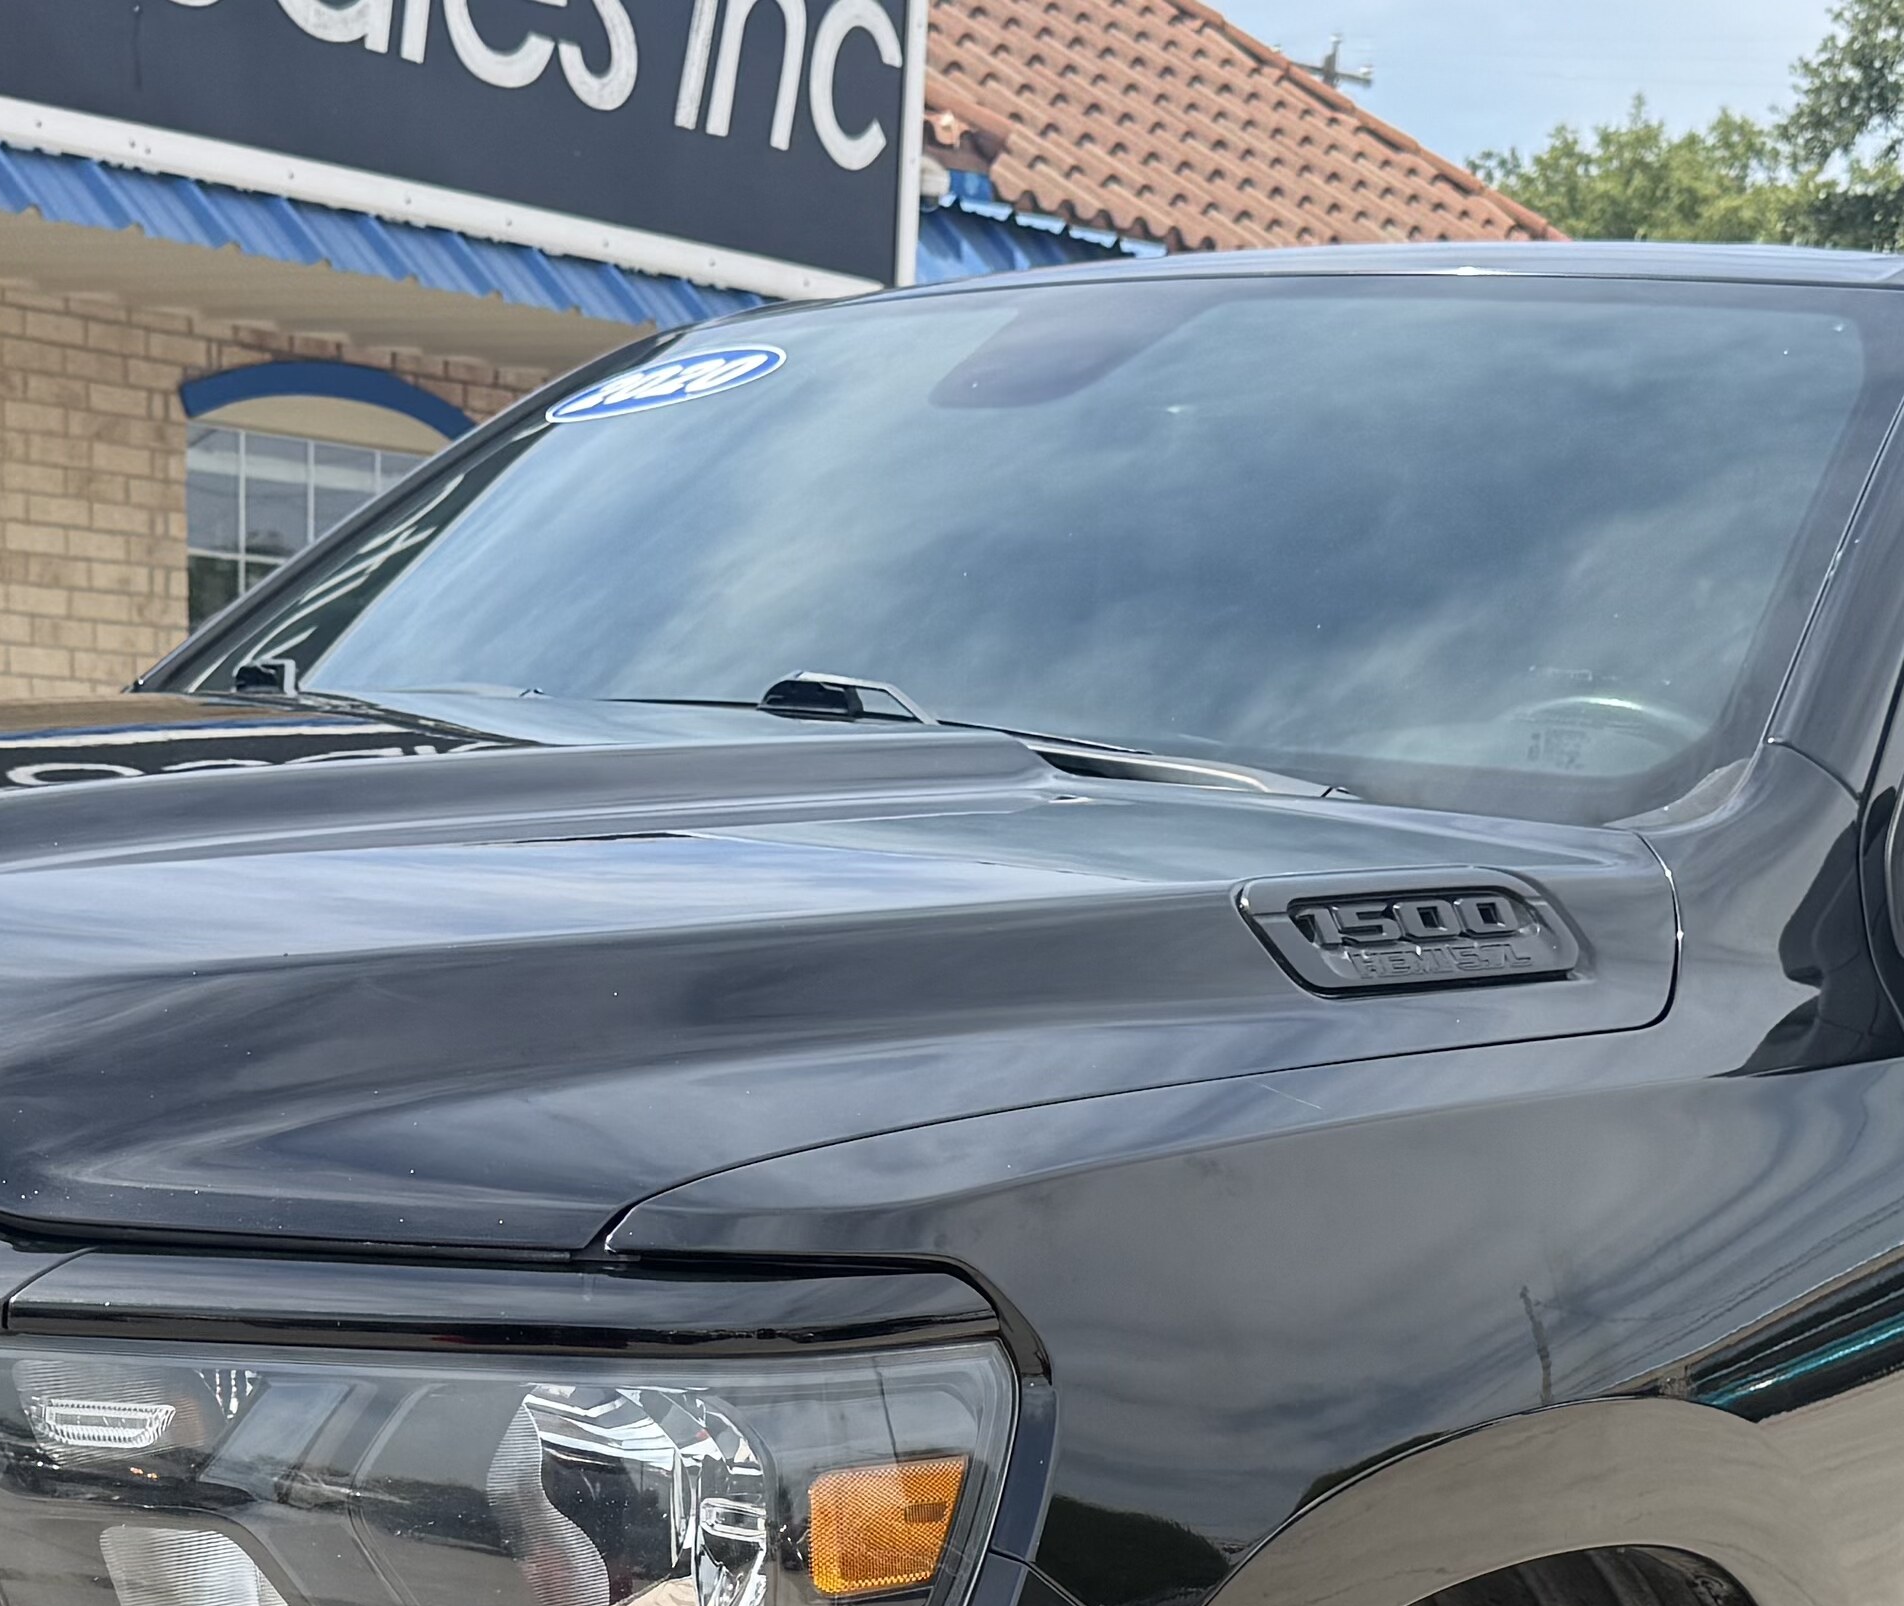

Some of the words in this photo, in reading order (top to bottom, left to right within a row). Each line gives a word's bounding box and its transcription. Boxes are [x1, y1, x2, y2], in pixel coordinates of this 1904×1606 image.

[556, 353, 769, 416] 2020
[1296, 897, 1520, 949] 1500
[1346, 948, 1451, 979] HEMI
